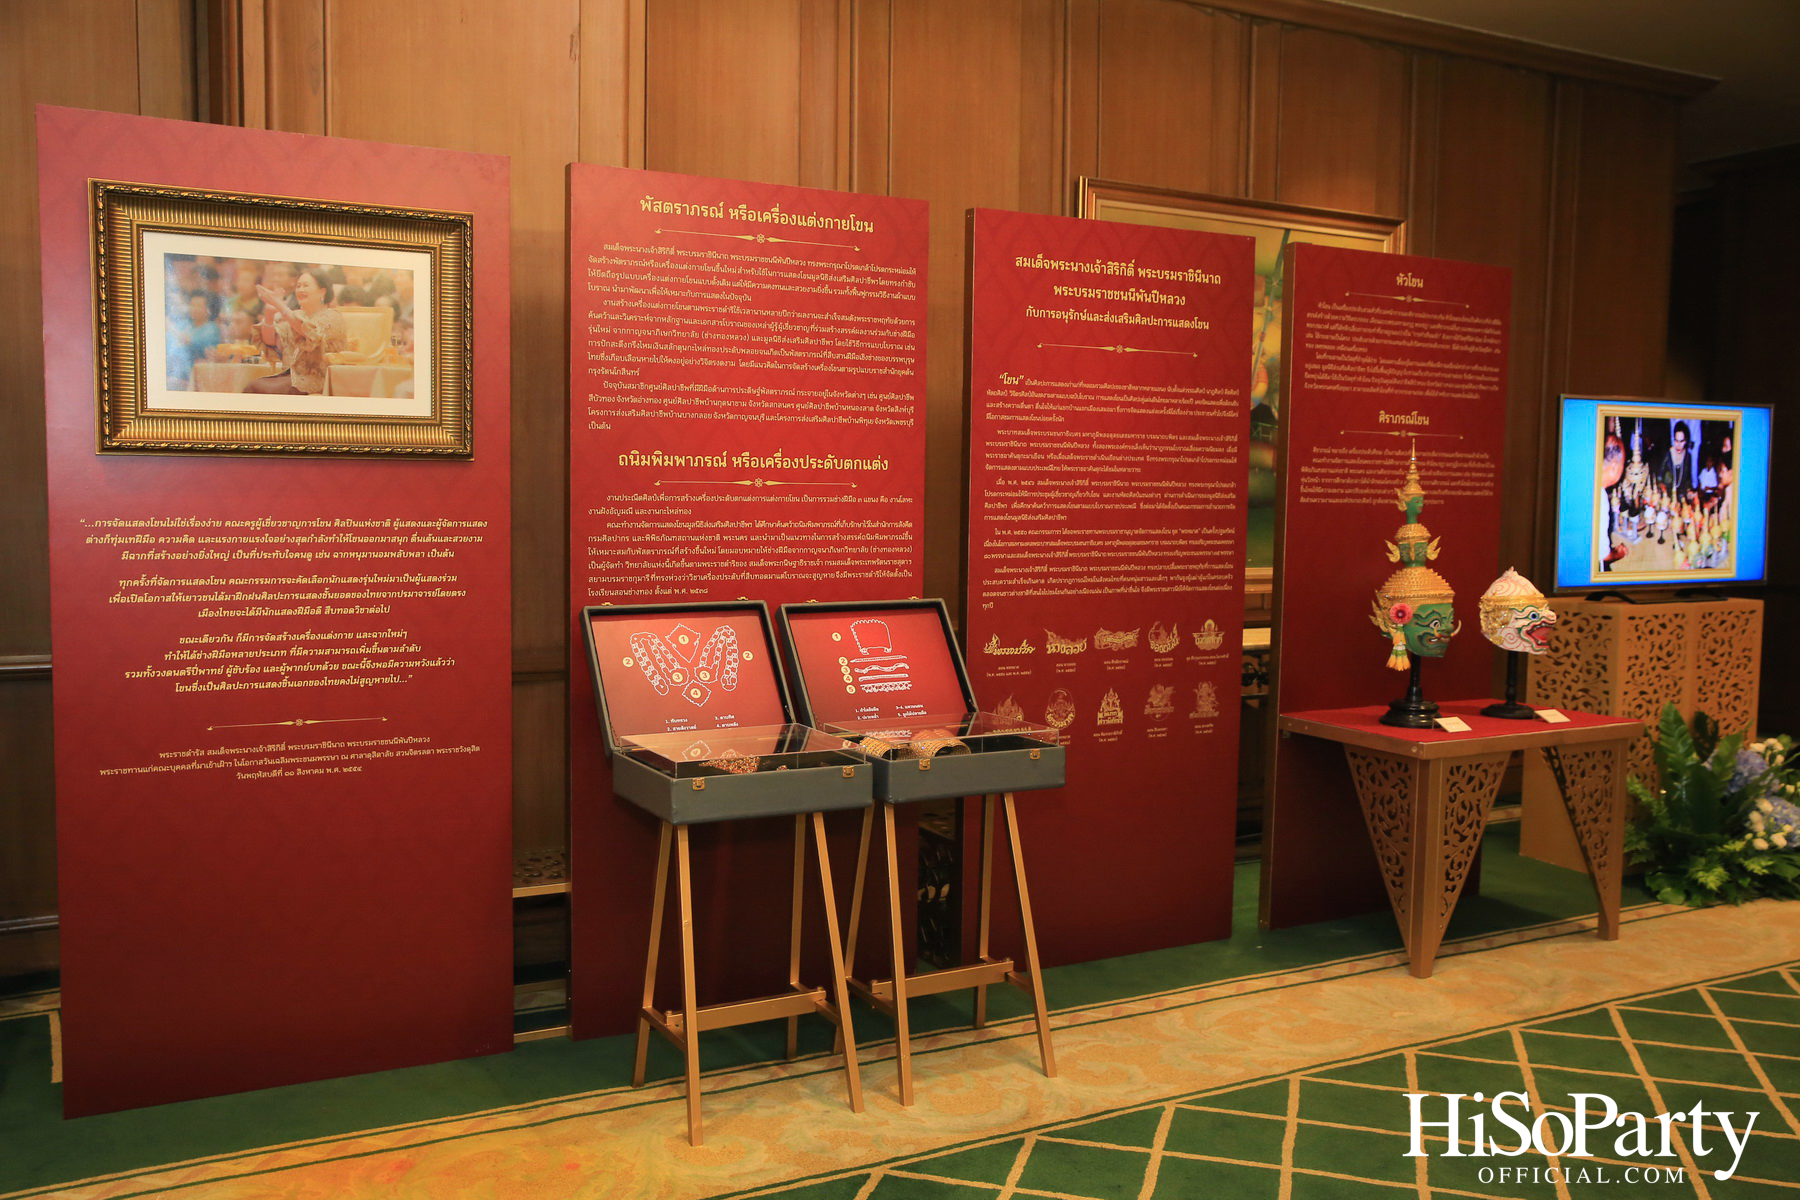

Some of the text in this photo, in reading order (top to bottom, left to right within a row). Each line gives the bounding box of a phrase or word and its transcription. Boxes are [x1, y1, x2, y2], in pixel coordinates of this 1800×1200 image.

[640, 195, 873, 233] พัสตราภรณ์ หรือเครื่องแต่งกายโขน
[1015, 253, 1221, 284] สมเด็จพระนางเจ้าสิริกิติ์ พระบรมราชินีนาถ
[1397, 272, 1424, 288] หัวโขน
[1053, 285, 1185, 306] พระบรมราชชนนีพันปีหลวง
[1025, 305, 1209, 330] กับการอนุรักษ์และส่งเสริมศิลปะการแสดงโขน
[999, 372, 1024, 386] “โขน”
[1379, 410, 1430, 425] ศิราภรณ์โขน
[618, 449, 888, 470] ถนิมพิมพาภรณ์ หรือเครื่องประดับตกแต่ง
[224, 515, 332, 530] คณะครูผู้เชี่ยวชาญการโขน
[333, 518, 391, 527] ศิลปินแห่งชาติ
[392, 517, 488, 530] ผู้แสดงและผู้จัดการแสดง
[85, 533, 155, 547] ต่างก็ทุ่มเทฝีมือ
[158, 534, 195, 543] ความคิด
[410, 531, 483, 543] ตื่นเต้นและสวยงาม
[232, 547, 312, 561] เป็นที่ประทับใจคนดู
[314, 549, 330, 558] เช่น
[332, 549, 425, 561] ฉากหนุมานอมพลับพลา
[427, 547, 454, 558] เป็นต้น
[118, 573, 226, 590] ทุกครั้งที่จัดการแสดงโขน
[324, 603, 390, 615] สืบทอดวิชาต่อไป
[179, 633, 234, 644] ขณะเดียวกัน
[355, 628, 407, 639] และฉากใหม่ๆ
[124, 663, 225, 678] รวมทั้งวงดนตรีปี่พาทย์
[225, 663, 261, 677] ผู้ขับร้อง
[262, 660, 339, 675] และผู้พากย์บทด้วย
[159, 748, 205, 758] พระราชดำรัส
[287, 740, 345, 750] พระบรมราชินีนาถ
[346, 735, 430, 747] พระบรมราชชนนีพันปีหลวง
[350, 749, 394, 760] ศาลาดุสิดาลัย
[395, 748, 434, 757] สวนจิตรลดา
[435, 744, 480, 754] พระราชวังดุสิต
[236, 766, 283, 780] วันพฤหัสบดีที่
[296, 767, 324, 775] สิงหาคม
